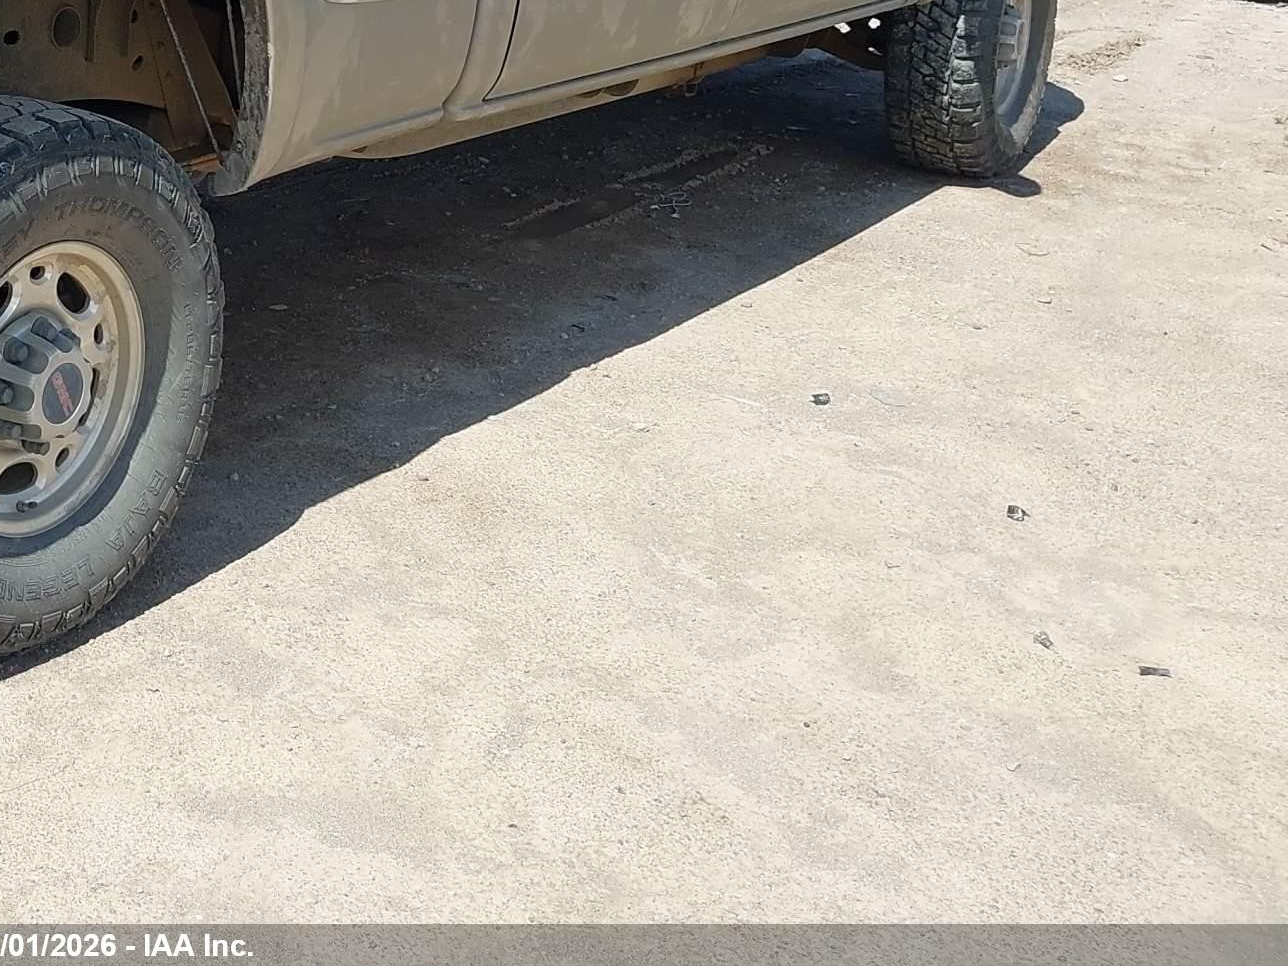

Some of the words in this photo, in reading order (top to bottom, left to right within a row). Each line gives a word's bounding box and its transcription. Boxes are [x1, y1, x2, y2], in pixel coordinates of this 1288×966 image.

[54, 196, 185, 272] THOMPSON
[52, 371, 75, 418] GMC
[104, 468, 167, 552] BAJA
